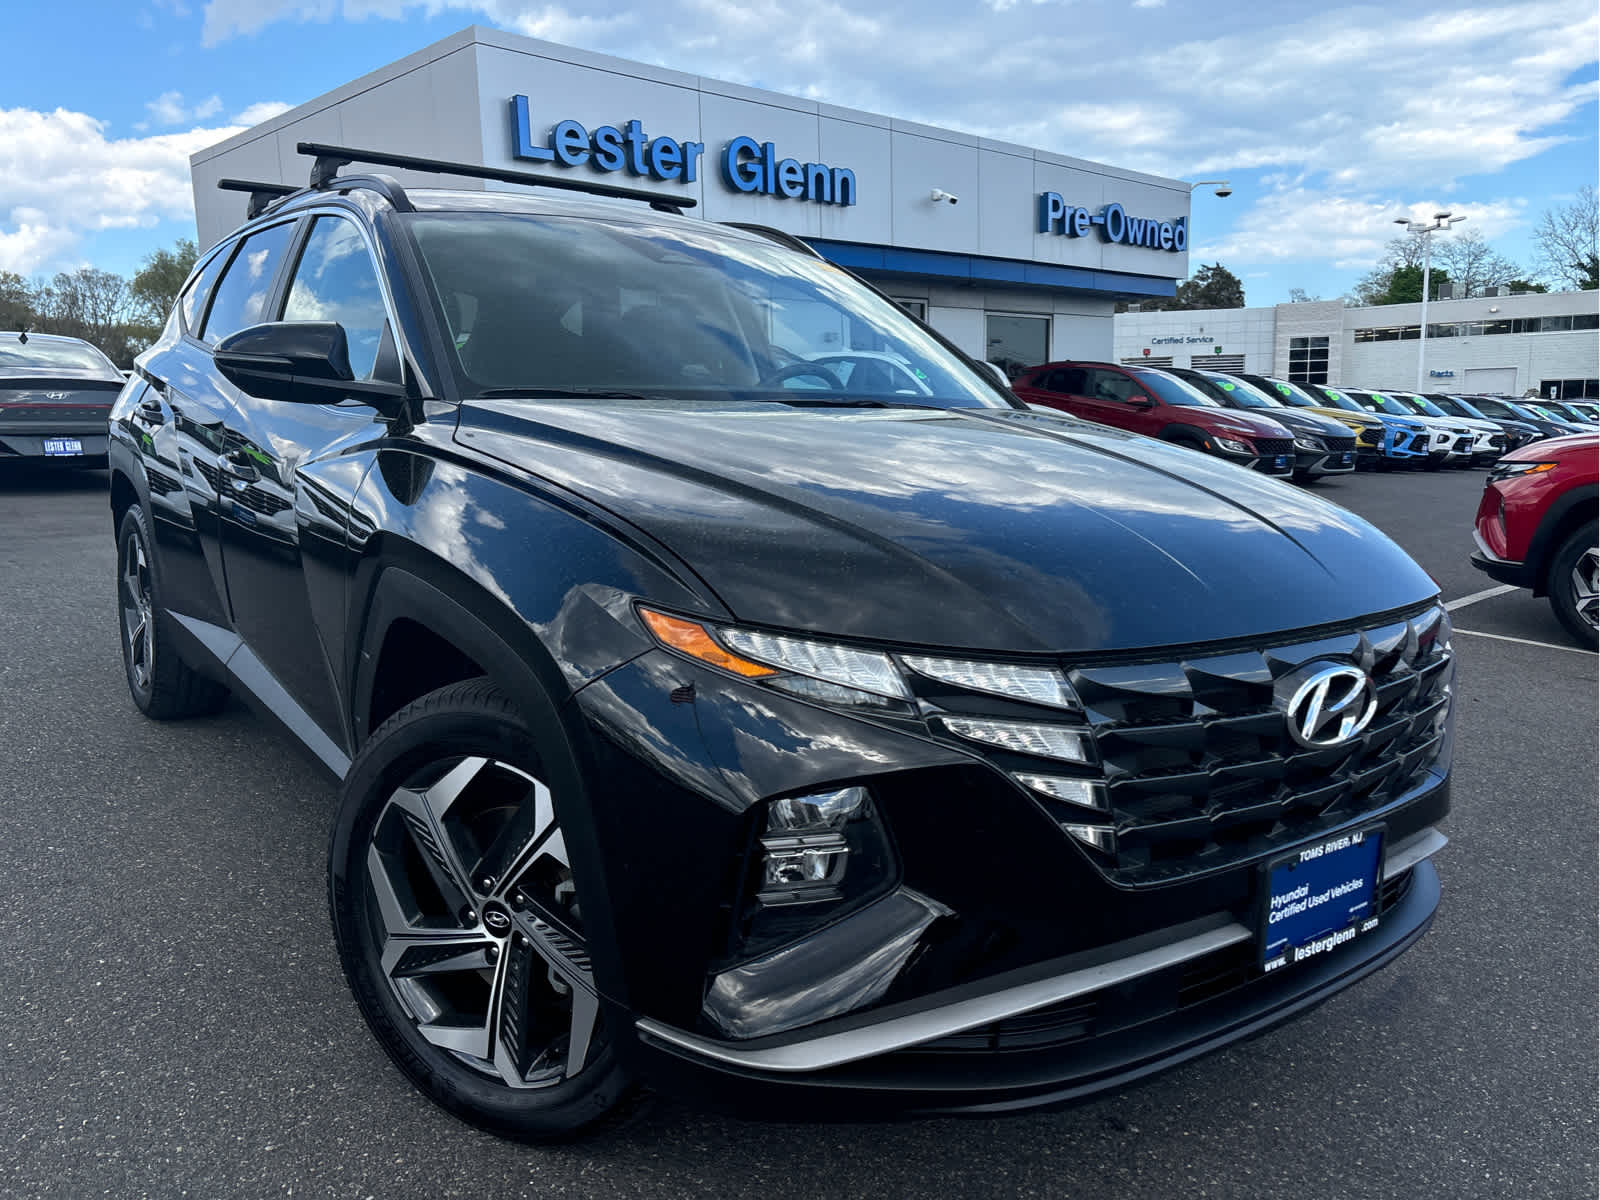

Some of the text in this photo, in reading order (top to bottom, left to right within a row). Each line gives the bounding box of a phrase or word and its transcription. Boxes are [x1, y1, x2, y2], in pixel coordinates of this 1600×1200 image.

[510, 94, 857, 207] Lester Glenn
[1039, 191, 1189, 252] Pre-Owned
[1151, 335, 1215, 345] Certified Service
[1430, 369, 1454, 378] Parts
[1299, 845, 1324, 863] TOMS
[1352, 831, 1364, 846] NJ
[1268, 898, 1307, 925] Certified
[1308, 890, 1331, 912] Used
[1331, 878, 1364, 899] Vehicles
[1270, 883, 1310, 910] Hyundai
[1294, 927, 1356, 962] lesterglenn
[1360, 917, 1380, 932] .com
